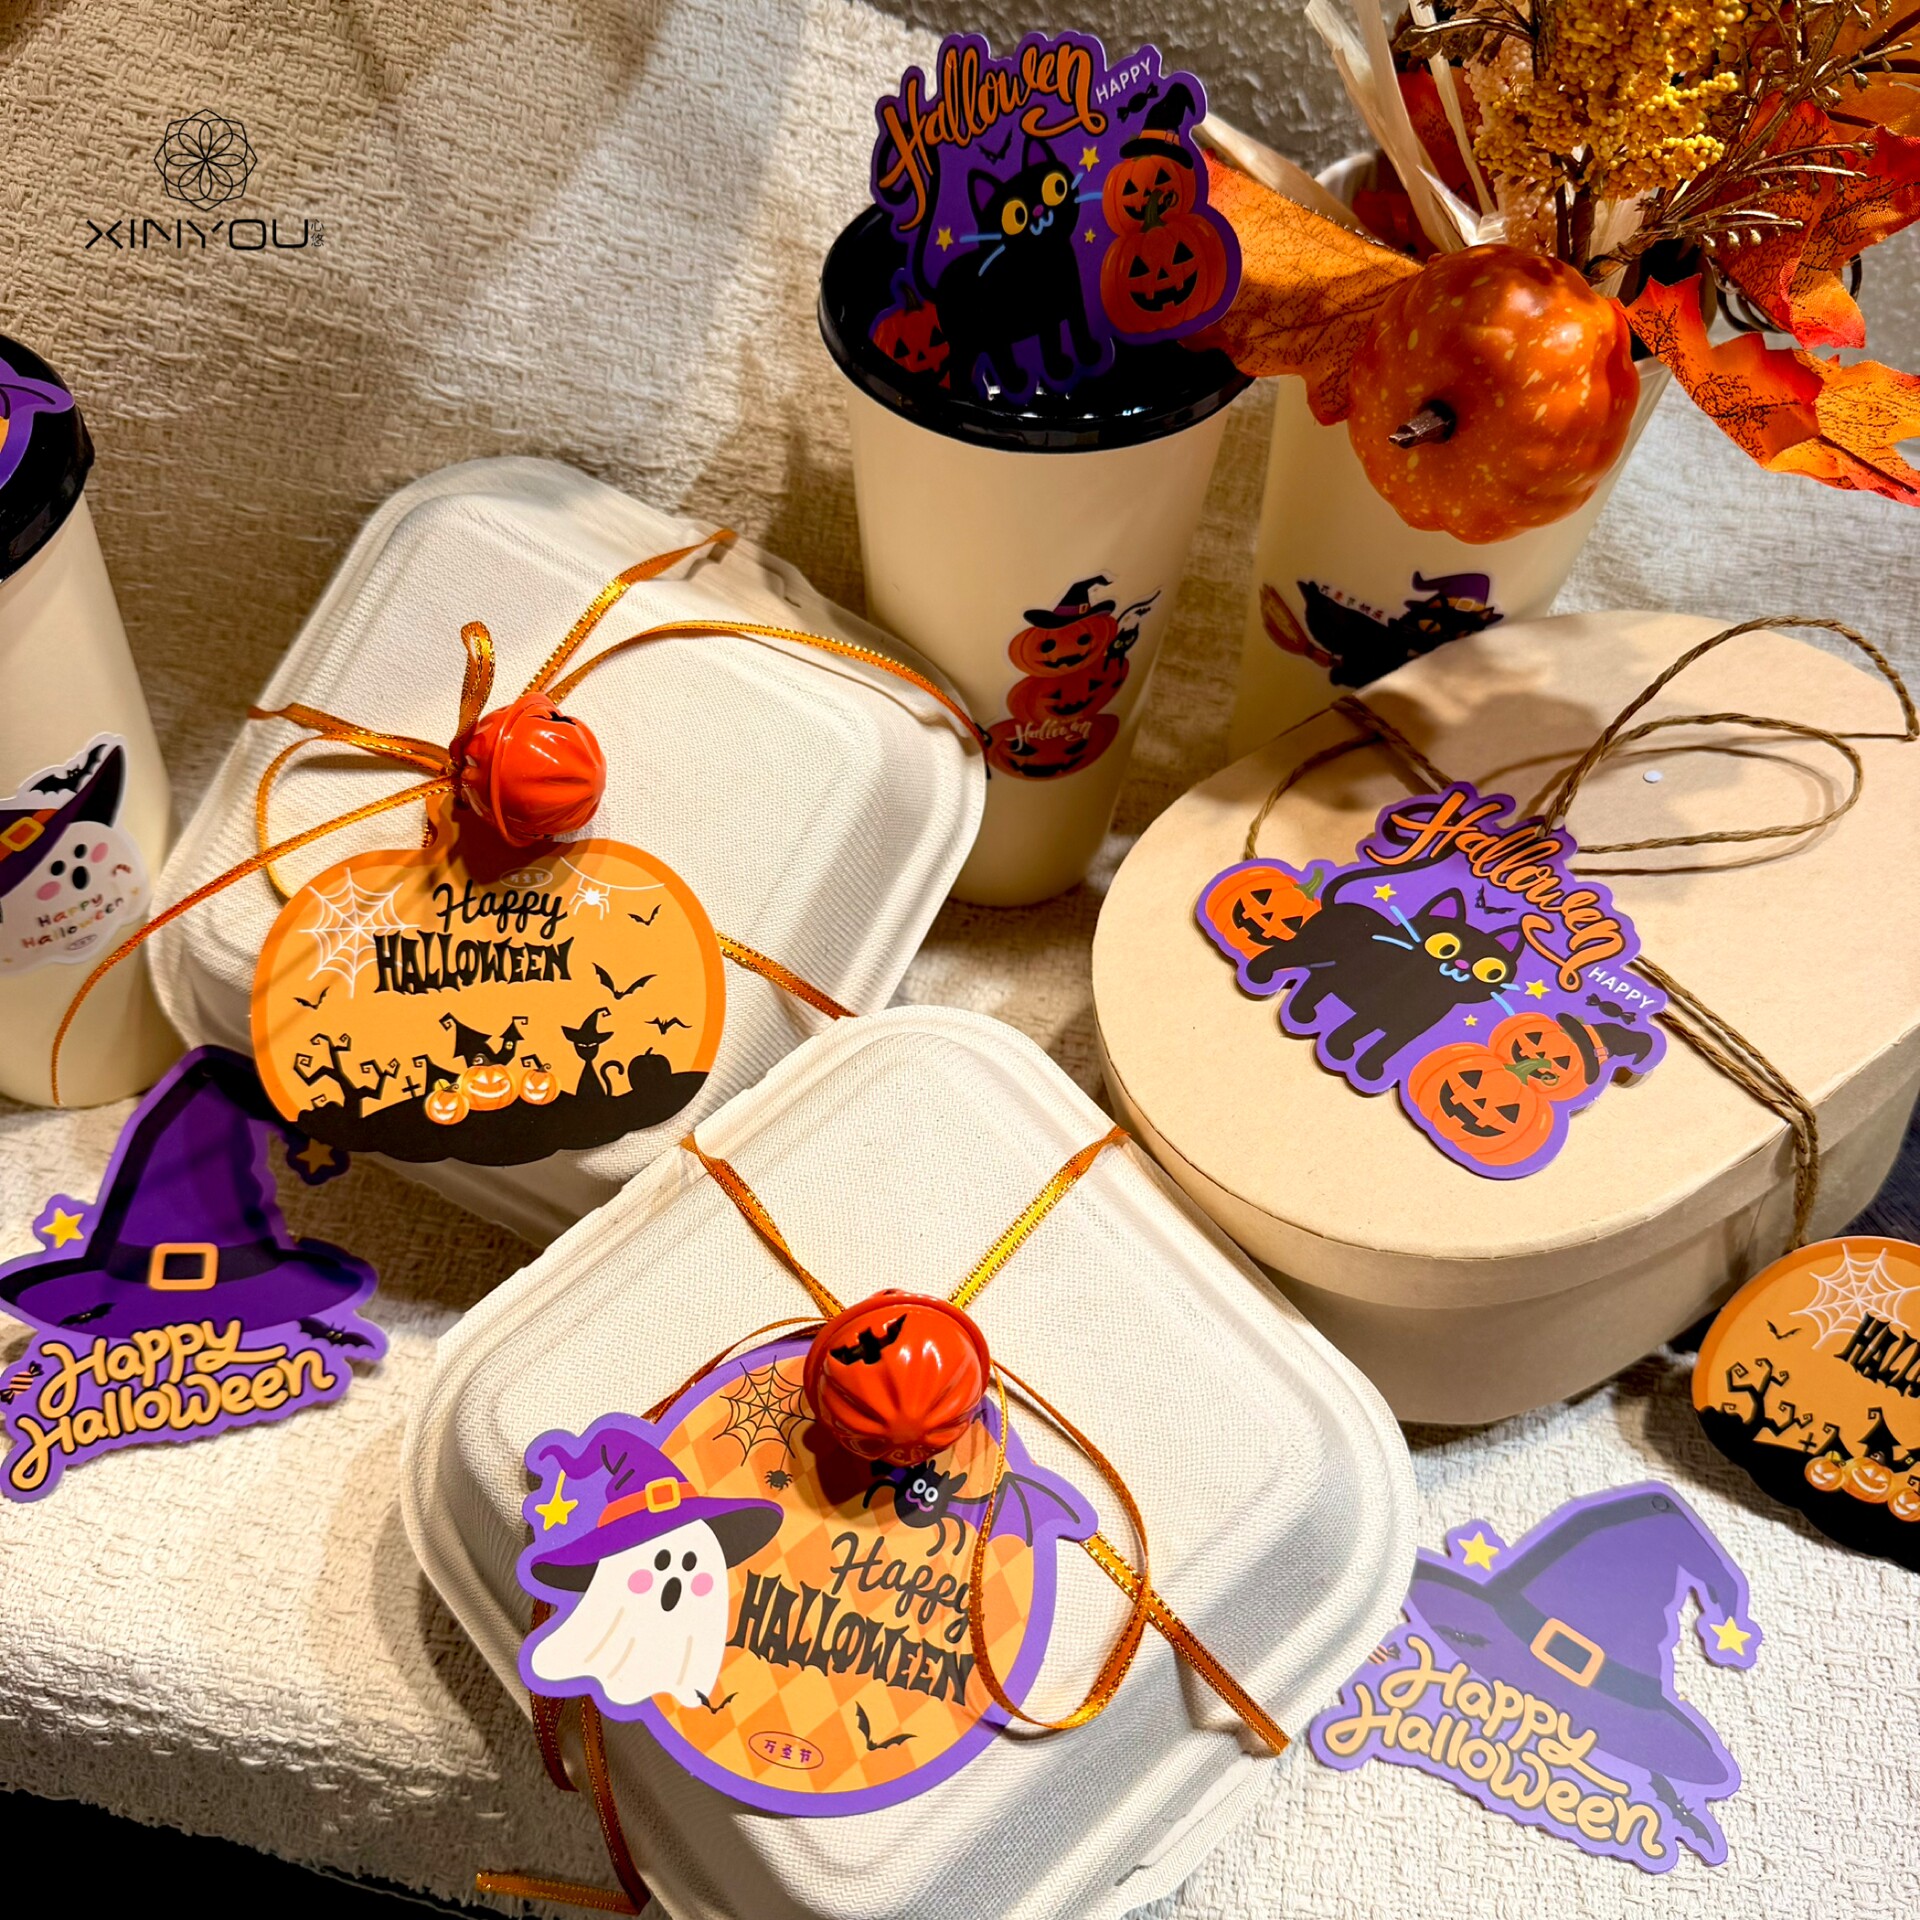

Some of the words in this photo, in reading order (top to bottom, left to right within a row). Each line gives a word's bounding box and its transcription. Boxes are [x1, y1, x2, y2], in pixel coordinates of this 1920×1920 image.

[1095, 56, 1152, 104] HAPPY
[37, 893, 104, 928] Happy
[432, 878, 569, 940] Happy
[1363, 790, 1627, 993] Halloween
[372, 929, 575, 996] HALLOWEEN
[1587, 966, 1655, 1010] HAPPY
[38, 1319, 288, 1419] Happy
[10, 1349, 336, 1491] Halloween
[725, 1568, 976, 1707] HALLOWEEN
[830, 1531, 971, 1644] Happy
[763, 1738, 813, 1764] 万圣节
[1380, 1635, 1630, 1796] Happy
[1324, 1683, 1666, 1859] Halloween
